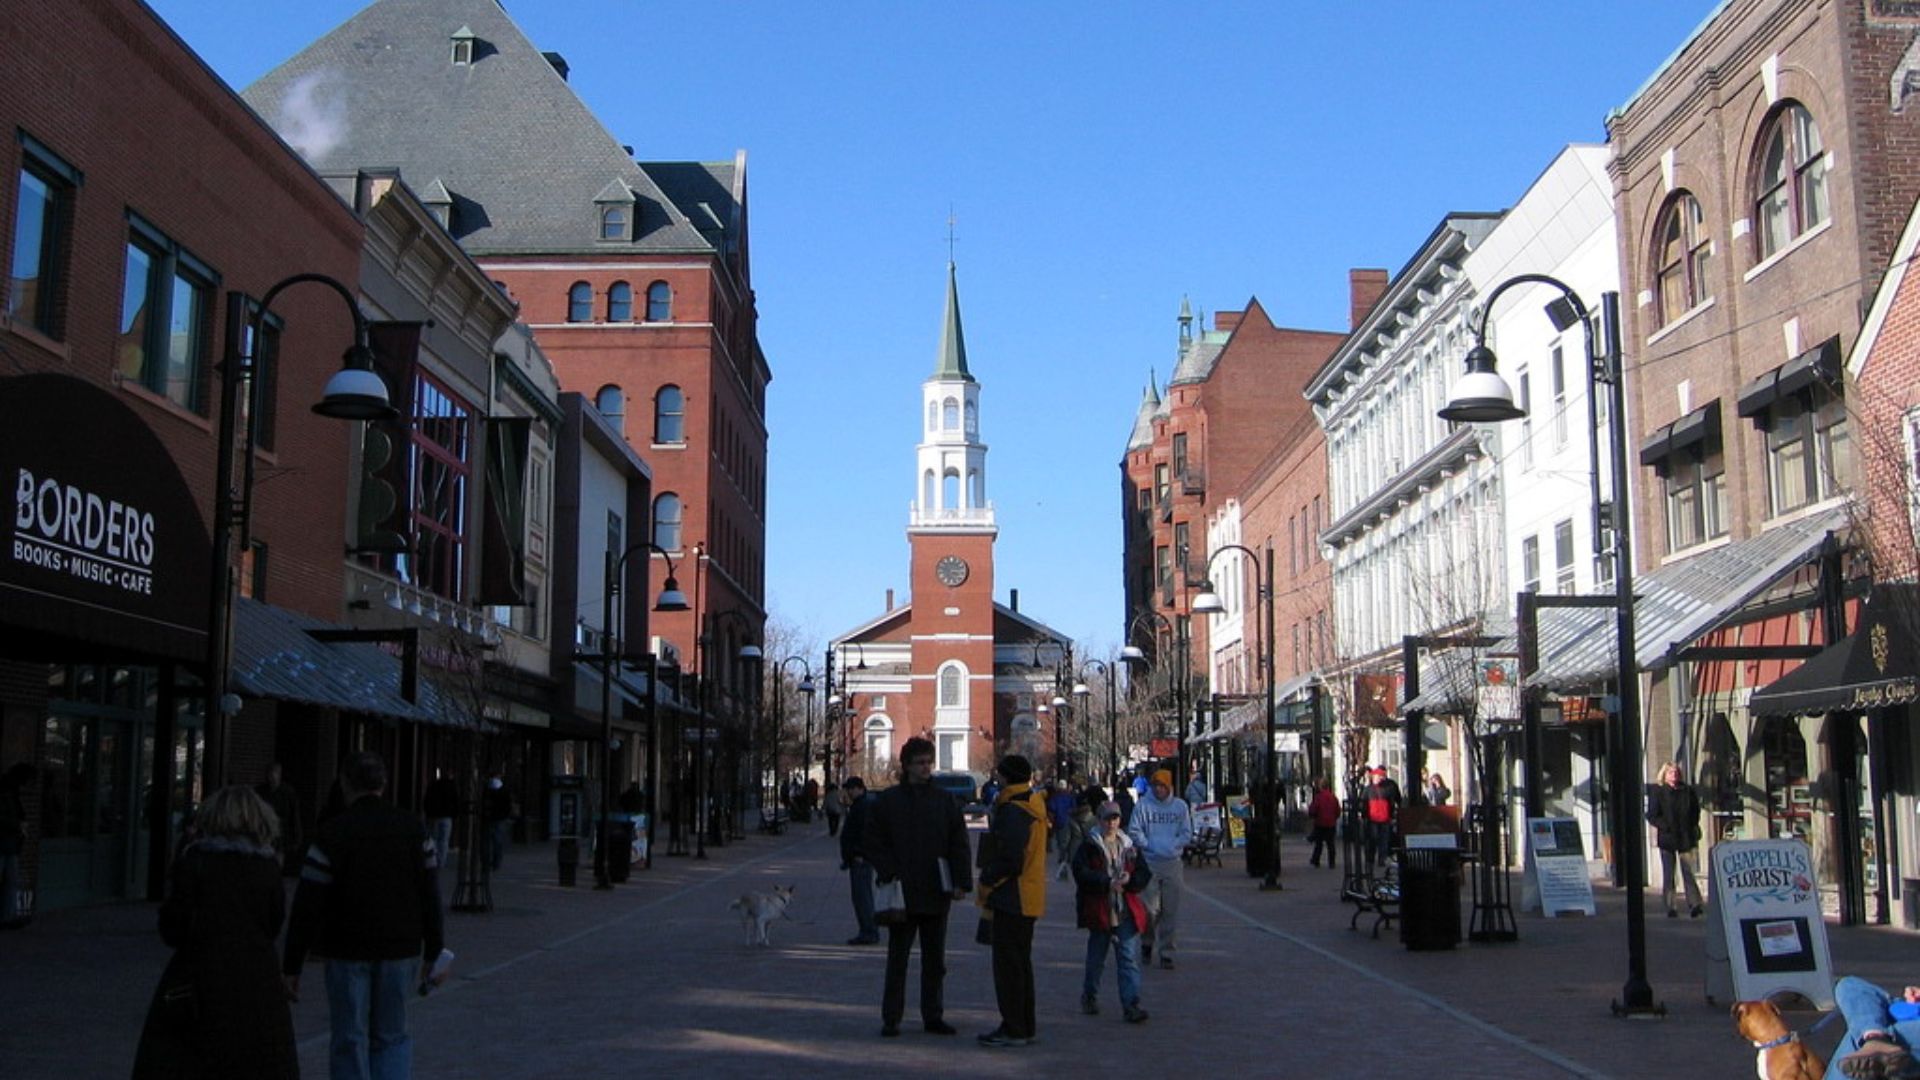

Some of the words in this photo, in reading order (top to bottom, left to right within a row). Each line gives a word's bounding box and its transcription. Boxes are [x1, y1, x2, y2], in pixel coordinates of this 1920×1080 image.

[16, 467, 155, 566] BORDERS
[14, 540, 62, 572] BOOKS
[70, 555, 113, 587] MUSIC
[121, 571, 152, 595] CAFE
[1723, 849, 1807, 875] CHAPPELL'S
[1728, 868, 1791, 888] FLORIST
